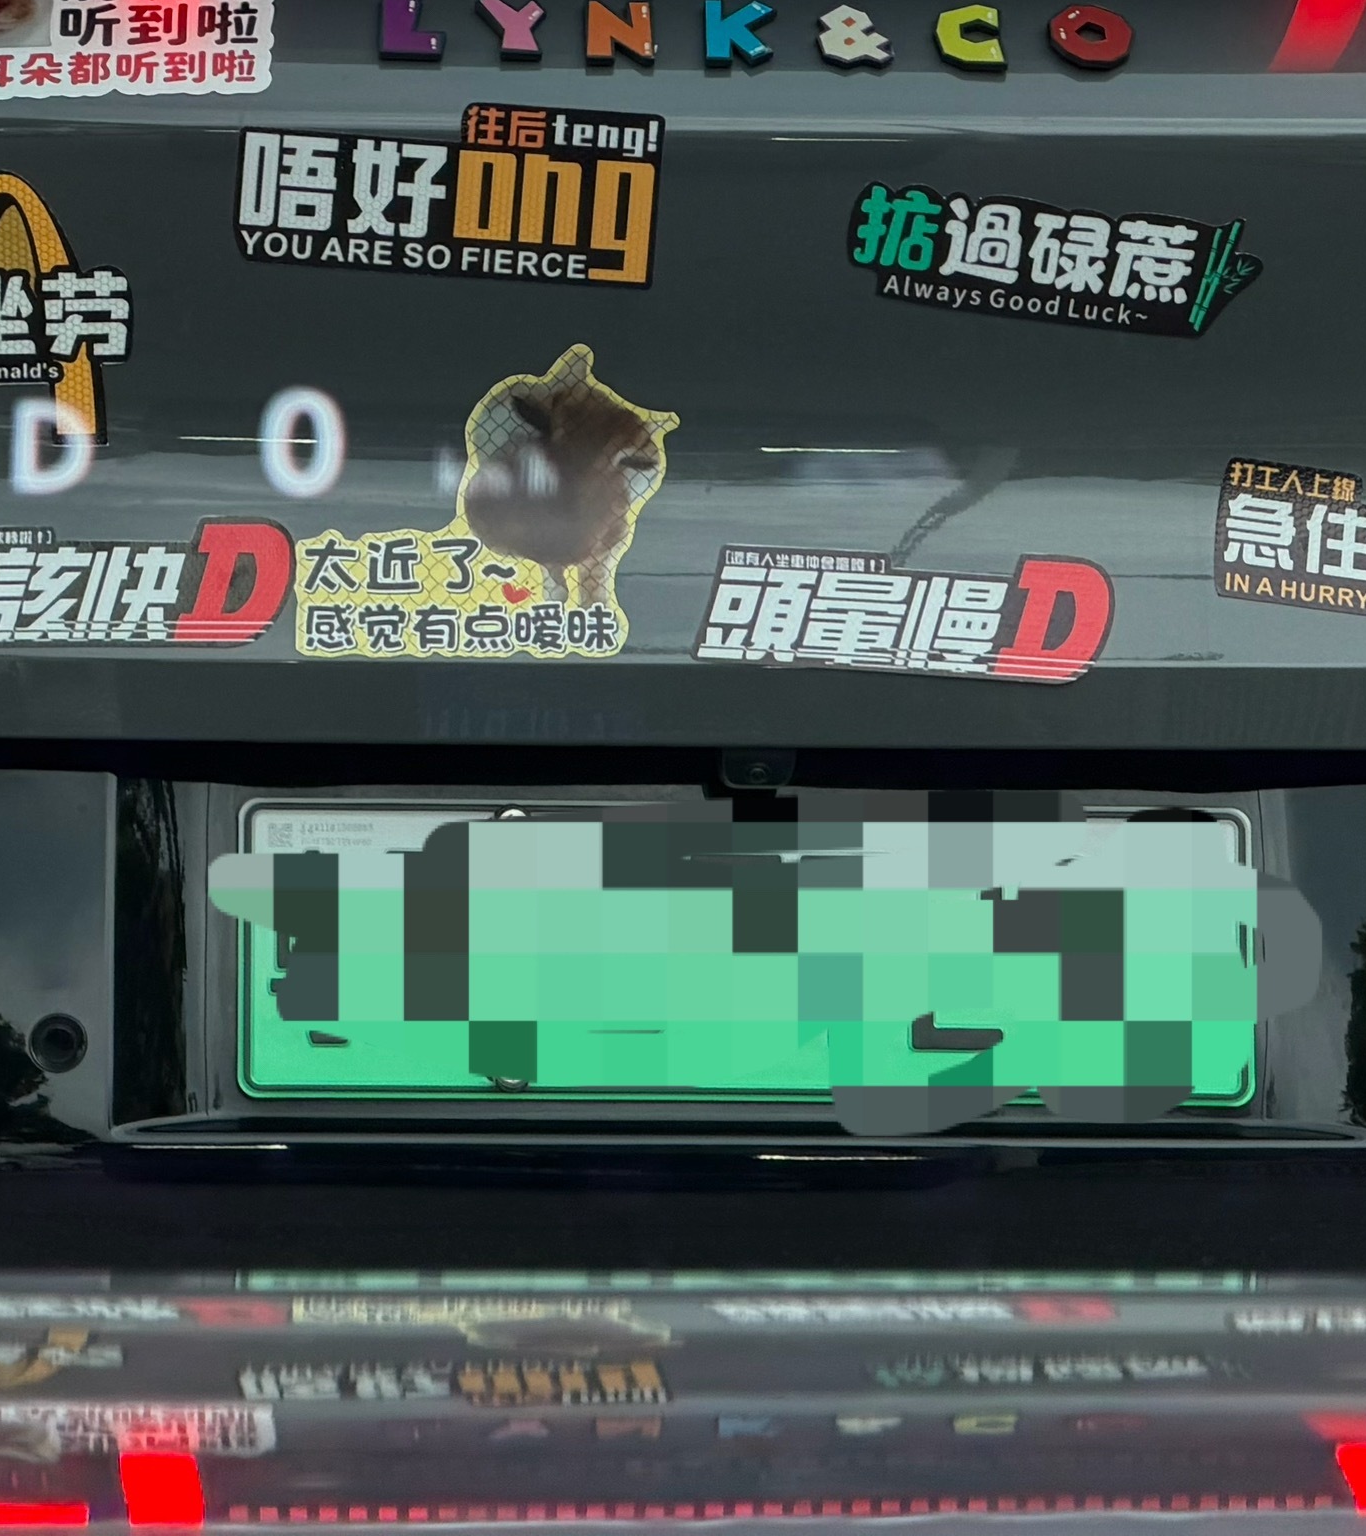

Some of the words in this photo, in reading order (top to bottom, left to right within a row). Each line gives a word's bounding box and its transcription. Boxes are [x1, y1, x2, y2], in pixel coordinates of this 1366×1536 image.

[60, 3, 258, 46] 听到啦
[241, 230, 312, 260] YOU
[321, 236, 393, 267] ARE
[402, 242, 451, 270] SO
[461, 246, 588, 279] FIERCE
[853, 185, 1199, 303] 掂過碌蔗
[884, 274, 981, 307] Always
[989, 288, 1060, 315] Good
[1225, 571, 1250, 594] IN
[1255, 574, 1275, 597] A
[304, 603, 618, 653] 感觉有点暧昧
